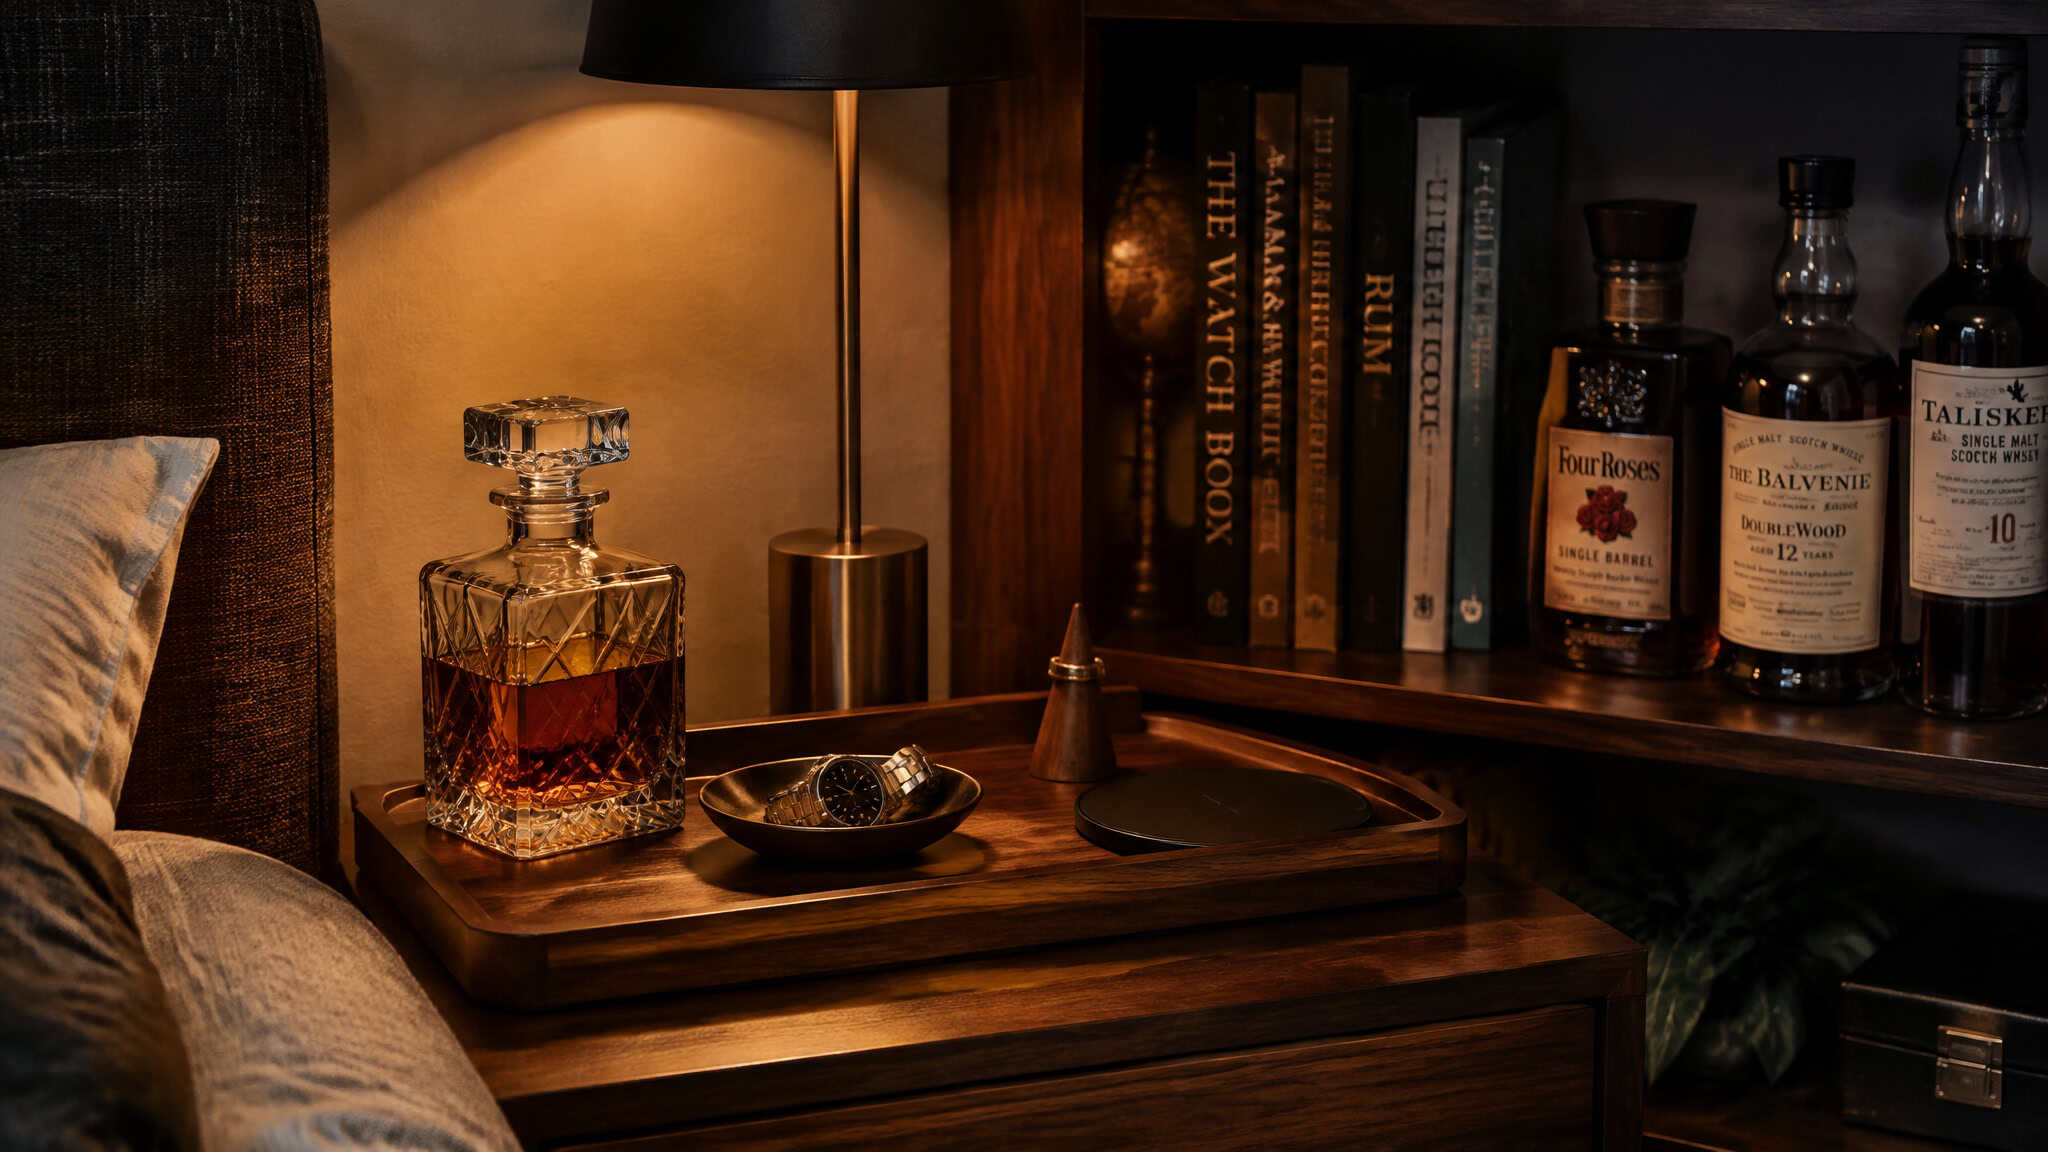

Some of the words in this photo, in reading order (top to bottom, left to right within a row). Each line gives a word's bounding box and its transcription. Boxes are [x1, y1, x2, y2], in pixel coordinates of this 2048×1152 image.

[1206, 151, 1238, 240] THE
[1206, 251, 1238, 415] WATCH
[1362, 272, 1395, 376] RUM
[1757, 432, 1782, 445] MALT
[1961, 433, 2006, 449] SINGLE
[2010, 432, 2039, 448] MALT
[1728, 463, 1753, 485] THE
[1757, 466, 1872, 492] BALVENIE
[1990, 512, 2016, 544] 10
[1558, 544, 1599, 563] SINGLE
[1776, 543, 1799, 562] 12
[1801, 550, 1834, 560] YEARS
